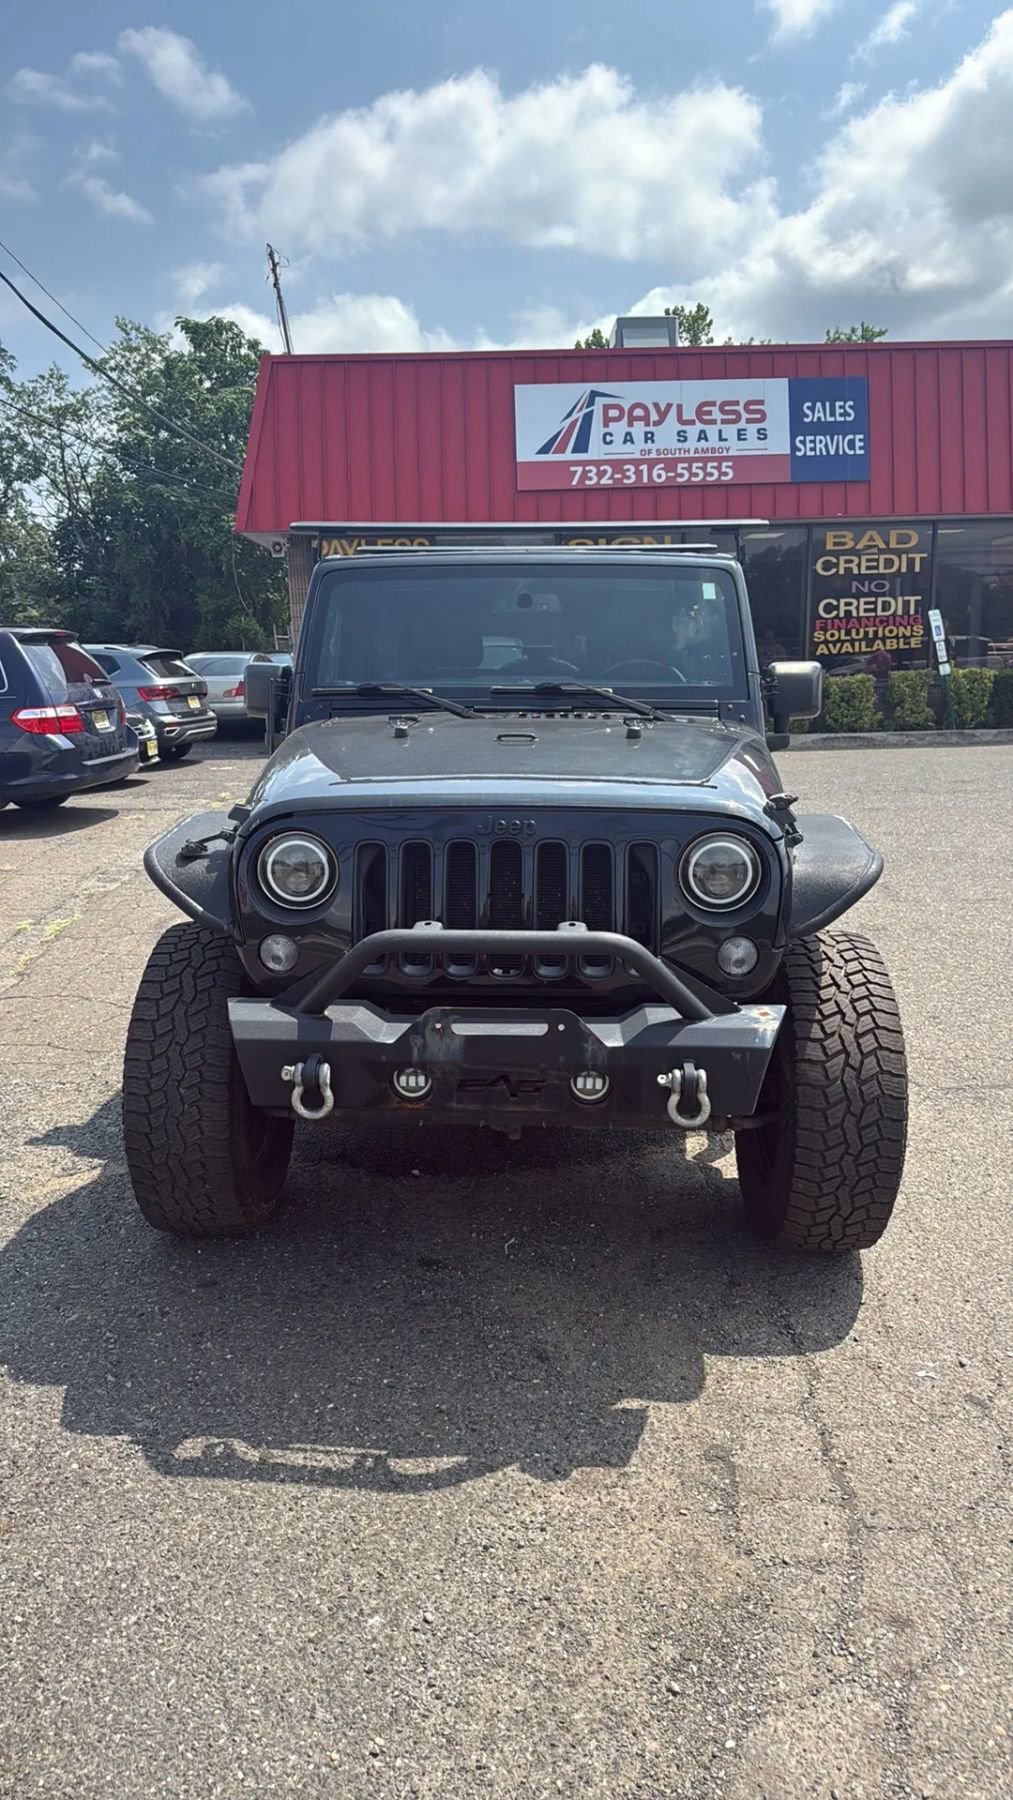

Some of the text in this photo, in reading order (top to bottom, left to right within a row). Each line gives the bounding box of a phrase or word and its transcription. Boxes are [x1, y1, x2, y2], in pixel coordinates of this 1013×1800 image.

[602, 399, 768, 428] PAYLESS
[803, 401, 855, 423] SALES
[602, 428, 768, 445] CAR SALES
[795, 434, 865, 457] SERVICE
[640, 446, 731, 457] OF SOUTH AMBOY
[569, 461, 734, 485] 732-316-5555
[825, 529, 919, 550] BAD
[815, 553, 928, 576] CREDIT
[851, 580, 890, 593] NO
[818, 596, 922, 618] CREDIT
[813, 624, 924, 642] SOLUTIONS
[815, 615, 922, 631] FINANCING
[815, 636, 922, 656] AVAILABLE
[476, 815, 537, 839] Jeep
